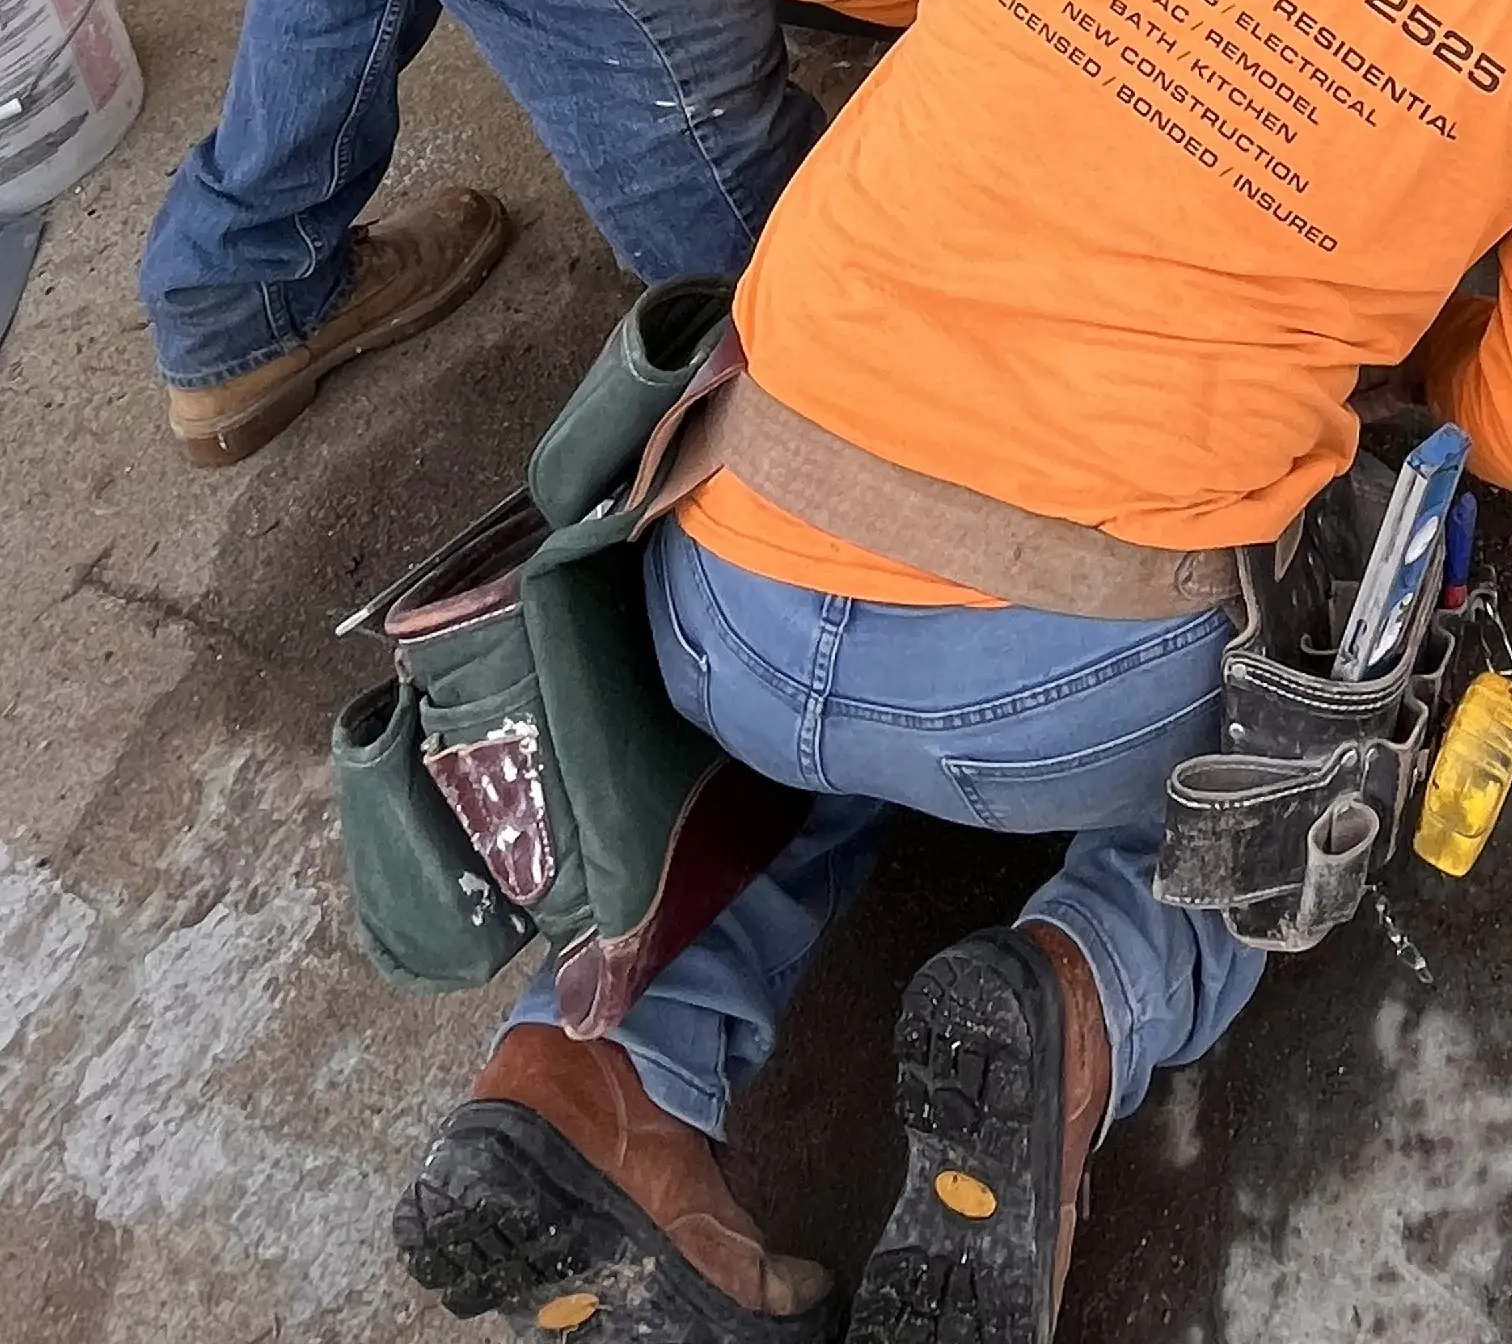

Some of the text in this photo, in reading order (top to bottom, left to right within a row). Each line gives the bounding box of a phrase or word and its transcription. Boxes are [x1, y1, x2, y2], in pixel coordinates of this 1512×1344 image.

[1061, 0, 1310, 194] NEW CONSTRUCTION
[1190, 58, 1298, 144] KITCHEN
[1204, 28, 1319, 126] REMODEL
[1234, 10, 1377, 128] ELECTRICAL
[1116, 82, 1219, 168] BONDED
[1232, 173, 1338, 253] INSURED
